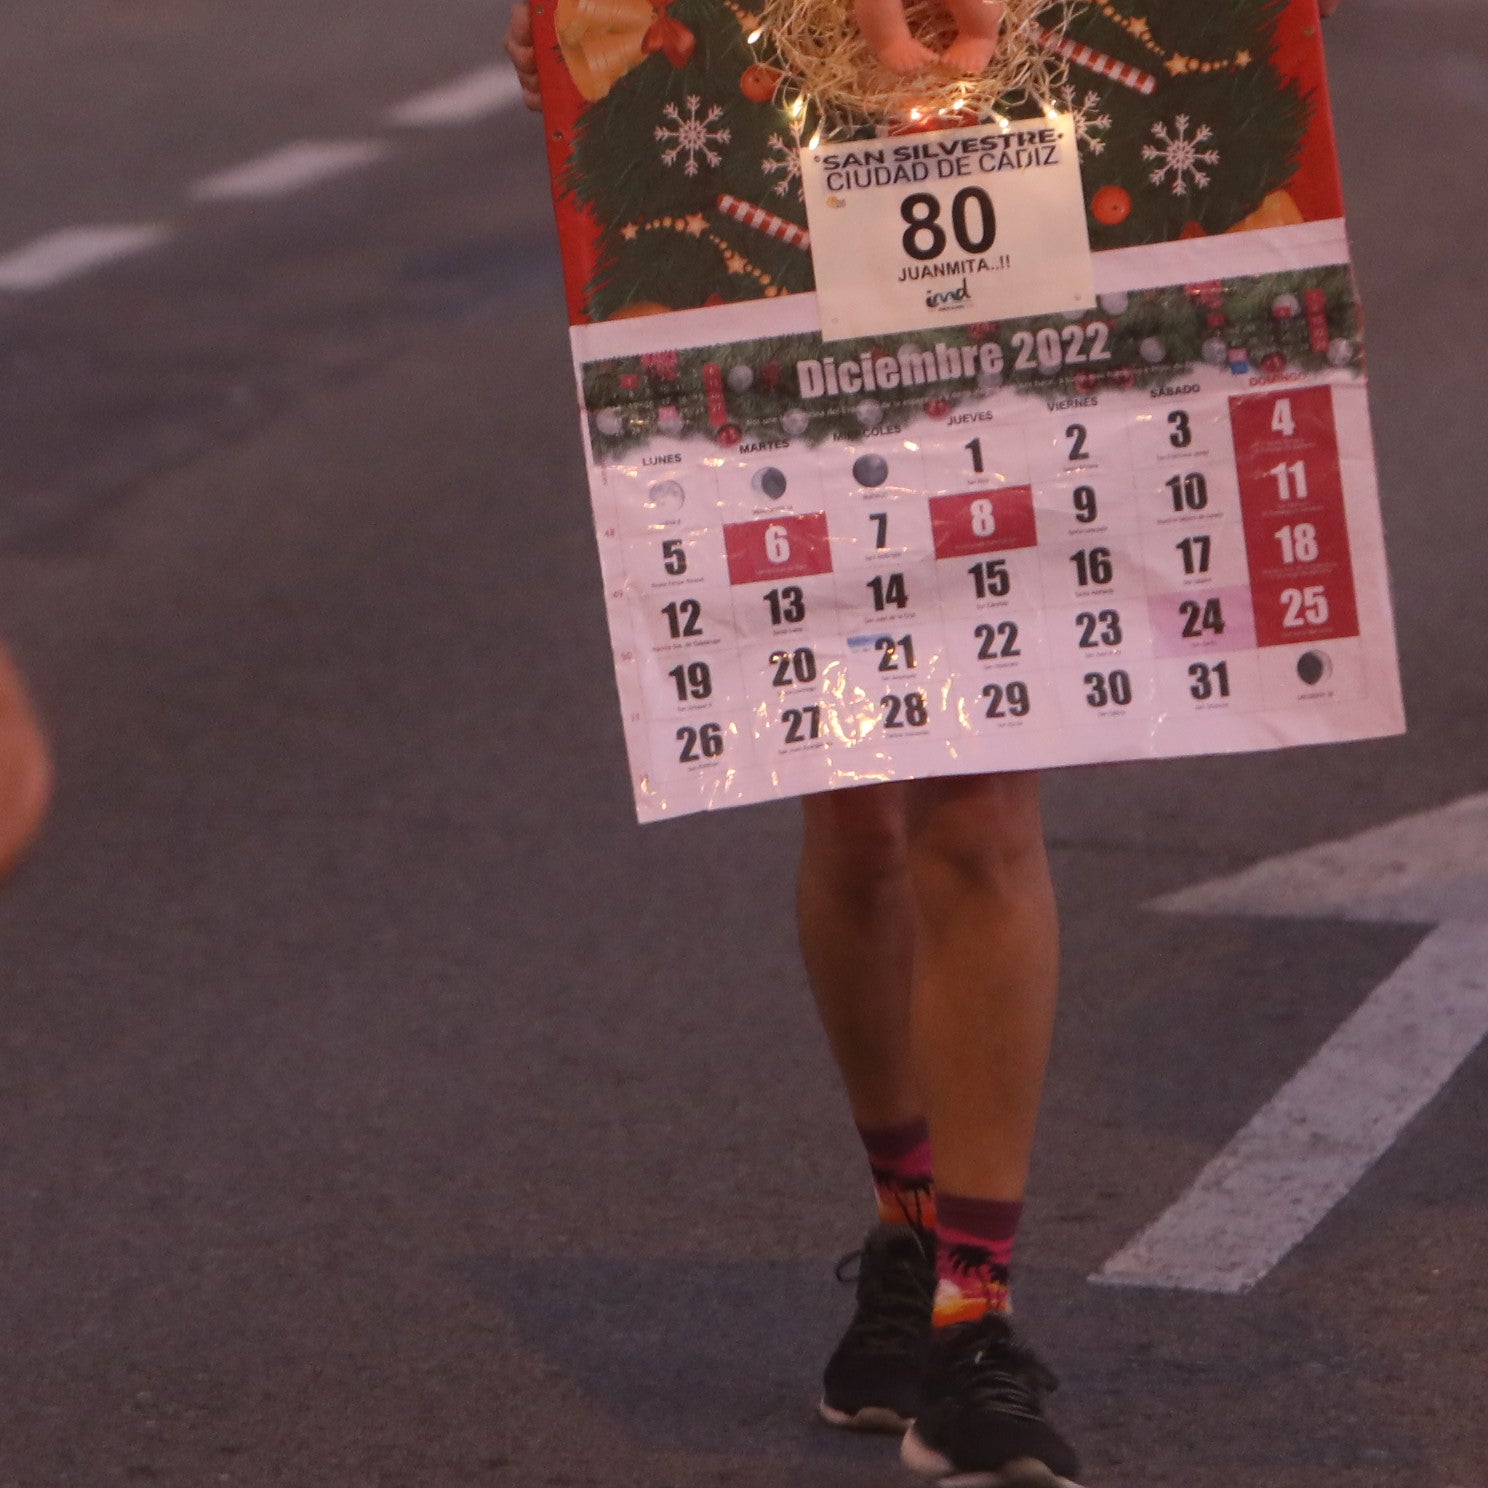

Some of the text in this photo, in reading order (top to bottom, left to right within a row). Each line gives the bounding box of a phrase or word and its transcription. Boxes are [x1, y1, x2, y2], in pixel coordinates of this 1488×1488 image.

[823, 128, 1056, 171] SAN SILVESTRE
[826, 161, 929, 192] CIUDAD
[938, 157, 972, 179] DE
[900, 185, 997, 261] 80
[796, 341, 1004, 399] Diciembre
[1011, 321, 1112, 370] 2022
[642, 454, 682, 467] LUNES
[738, 439, 791, 455] MARTES
[947, 412, 994, 426] JUEVES
[1046, 396, 1098, 413] VIERNES
[964, 398, 1296, 473] 1 2 3 4
[662, 460, 1310, 576] 5 6 7 8 9 10 11
[662, 522, 1320, 639] 12 13 14 15 16 17 18
[669, 585, 1329, 701] 19 20 21 22 23 24 25
[676, 661, 1231, 764] 26 27 28 29 30 31
